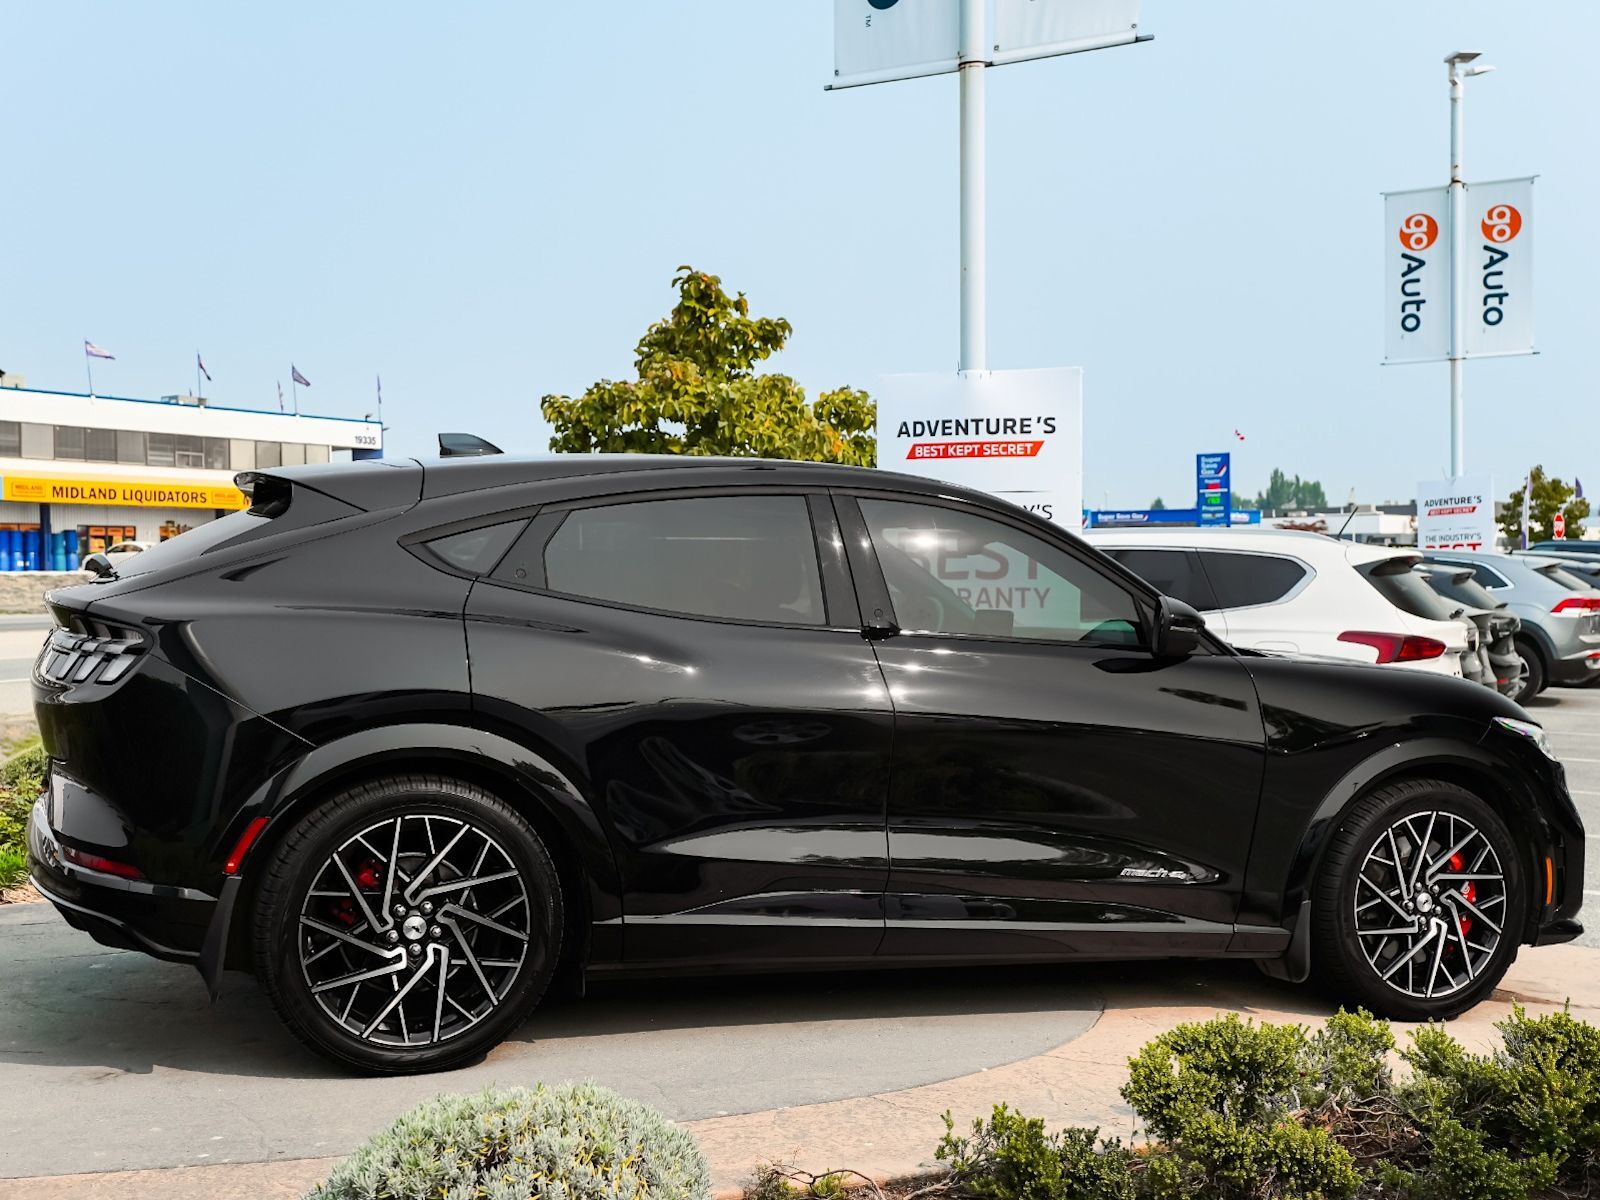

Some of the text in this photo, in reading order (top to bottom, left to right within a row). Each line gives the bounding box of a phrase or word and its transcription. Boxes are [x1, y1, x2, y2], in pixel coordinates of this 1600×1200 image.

[1400, 214, 1429, 333] go Auto
[1483, 206, 1511, 326] go Auto
[897, 416, 1056, 438] ADVENTURE'S
[354, 435, 377, 446] 19335
[915, 443, 1034, 457] BEST KEPT SECRET
[52, 486, 117, 500] MIDLAND
[122, 489, 207, 503] LIQUIDATORS
[1424, 496, 1482, 507] ADVENTURE'S
[1439, 533, 1482, 542] INDUSTRY'S
[955, 587, 1051, 609] RANTY
